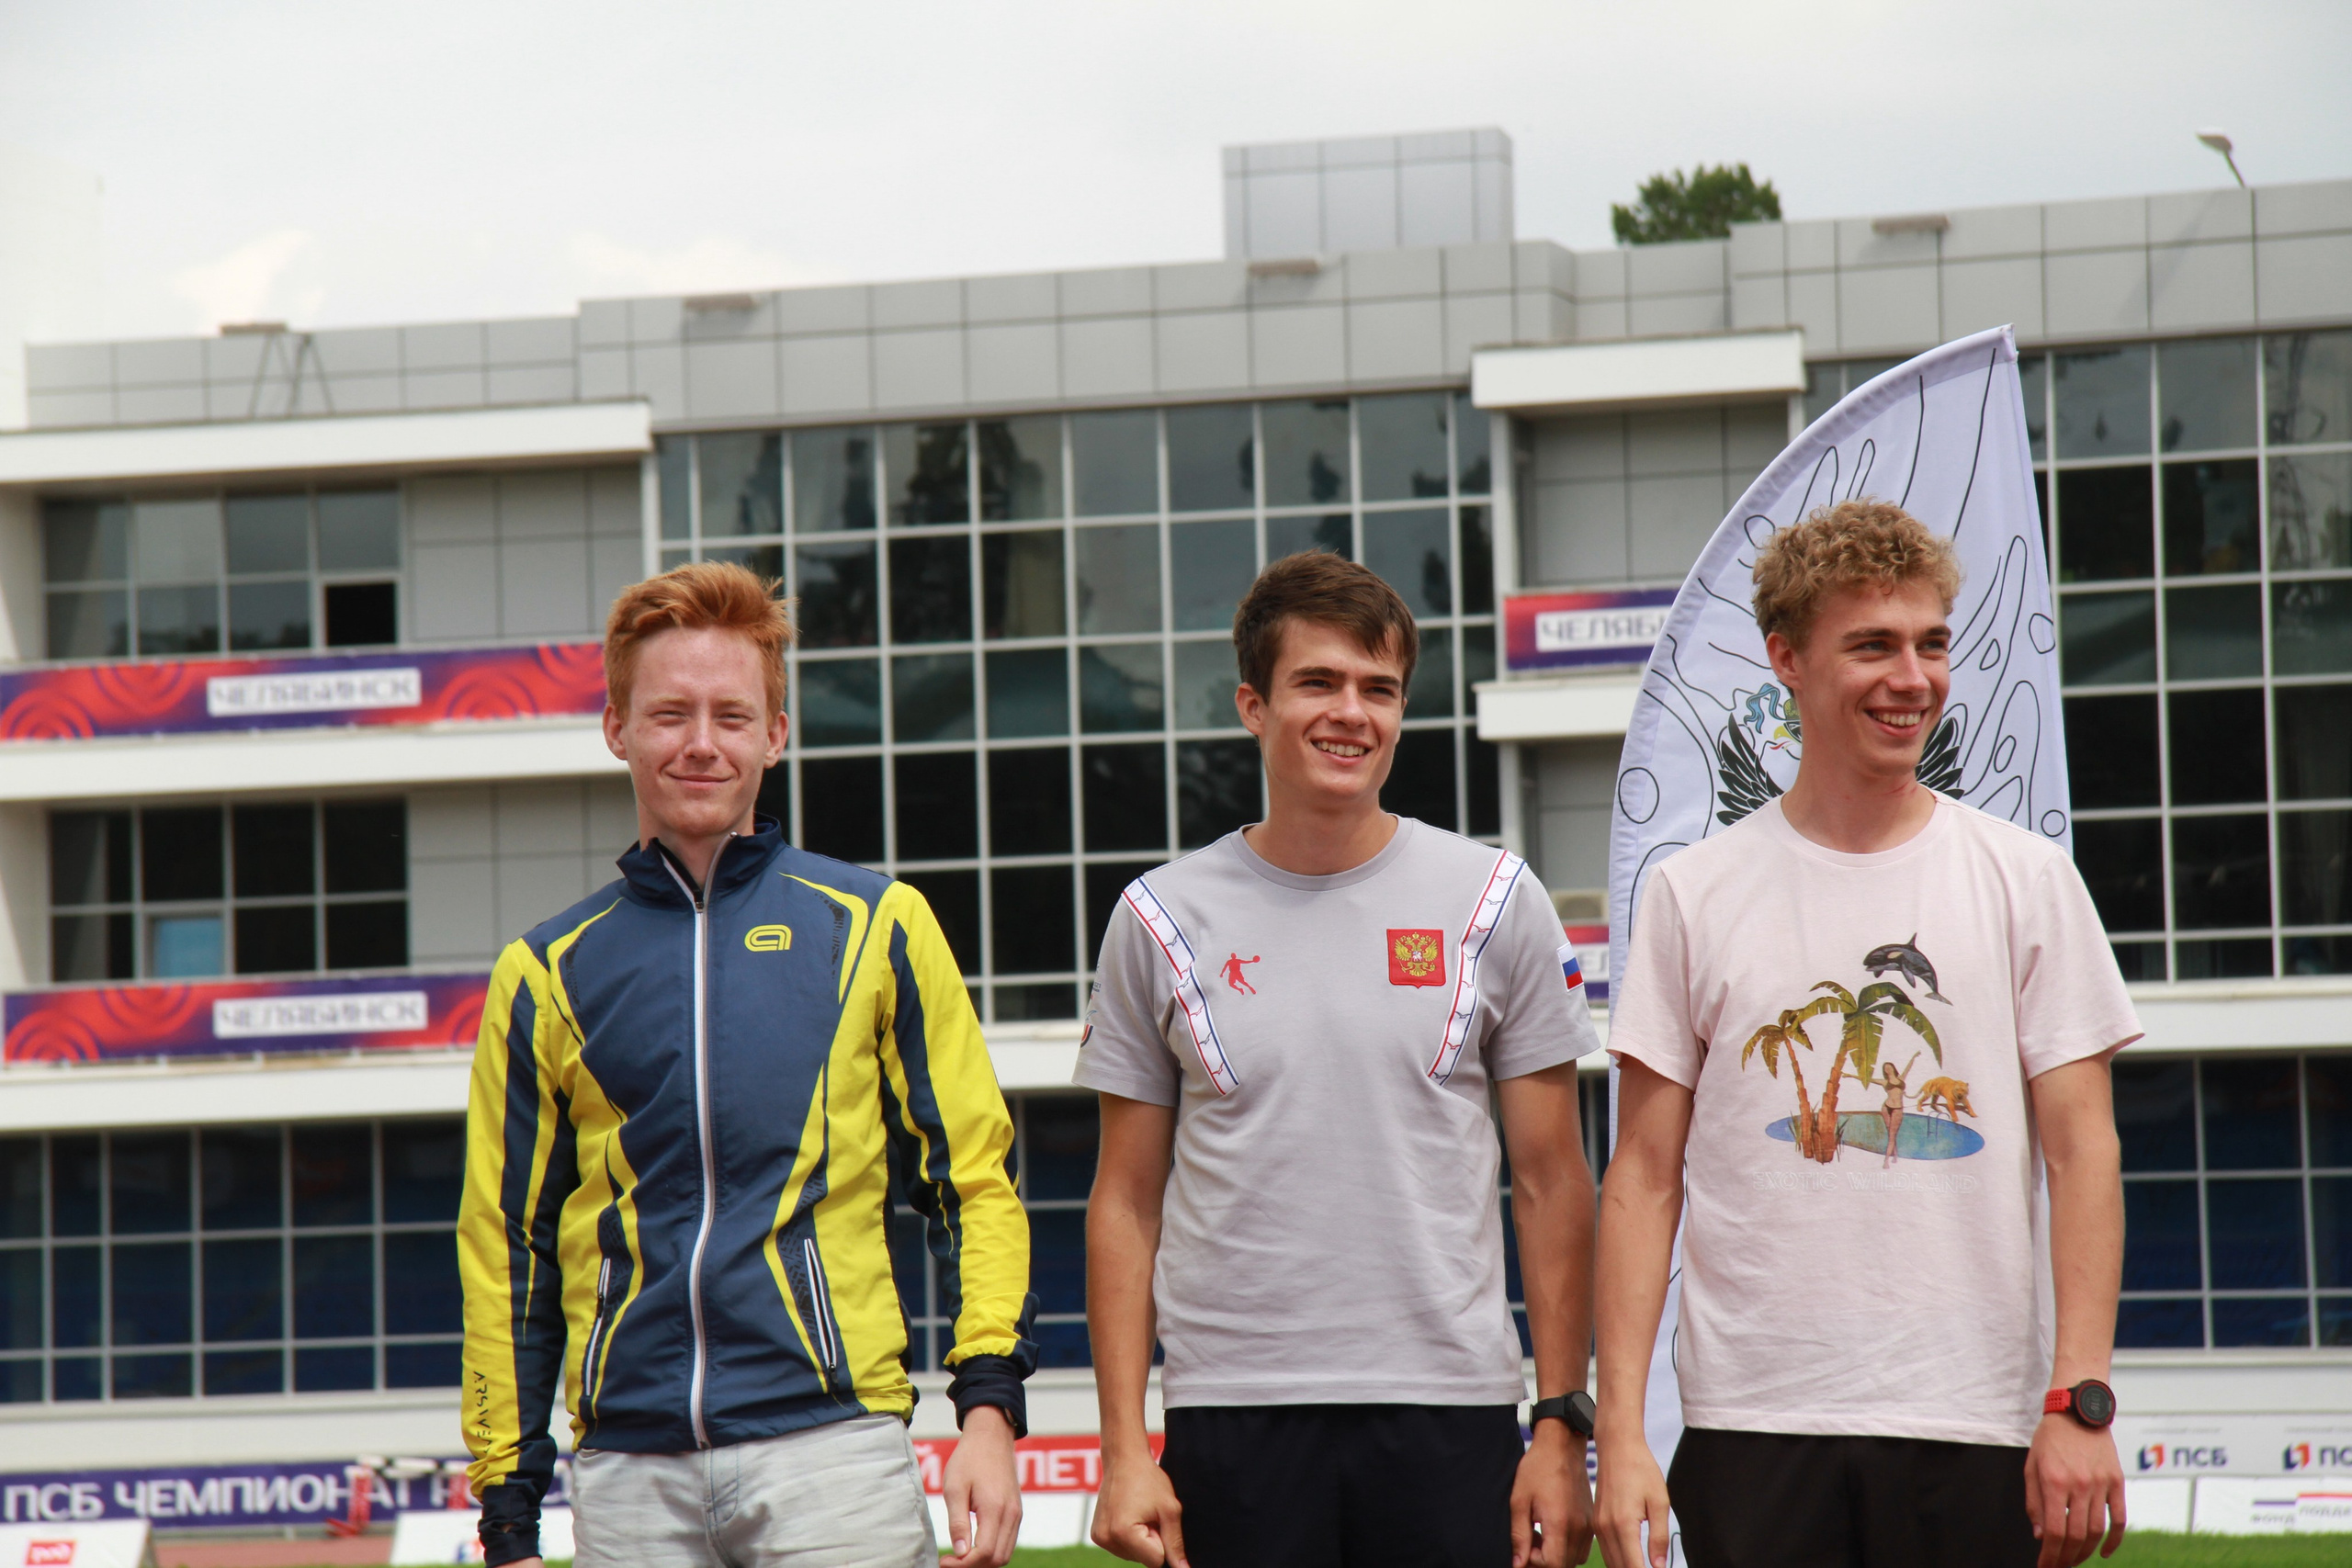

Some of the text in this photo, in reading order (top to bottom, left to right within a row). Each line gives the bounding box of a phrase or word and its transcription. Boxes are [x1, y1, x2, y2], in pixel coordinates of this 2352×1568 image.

[1543, 615, 1664, 640] ЧЕЛЯБ
[1753, 1171, 1976, 1193] EXOTIC WILDLAND
[2173, 1447, 2228, 1467] ПСБ
[5, 1481, 103, 1521] ПСБ
